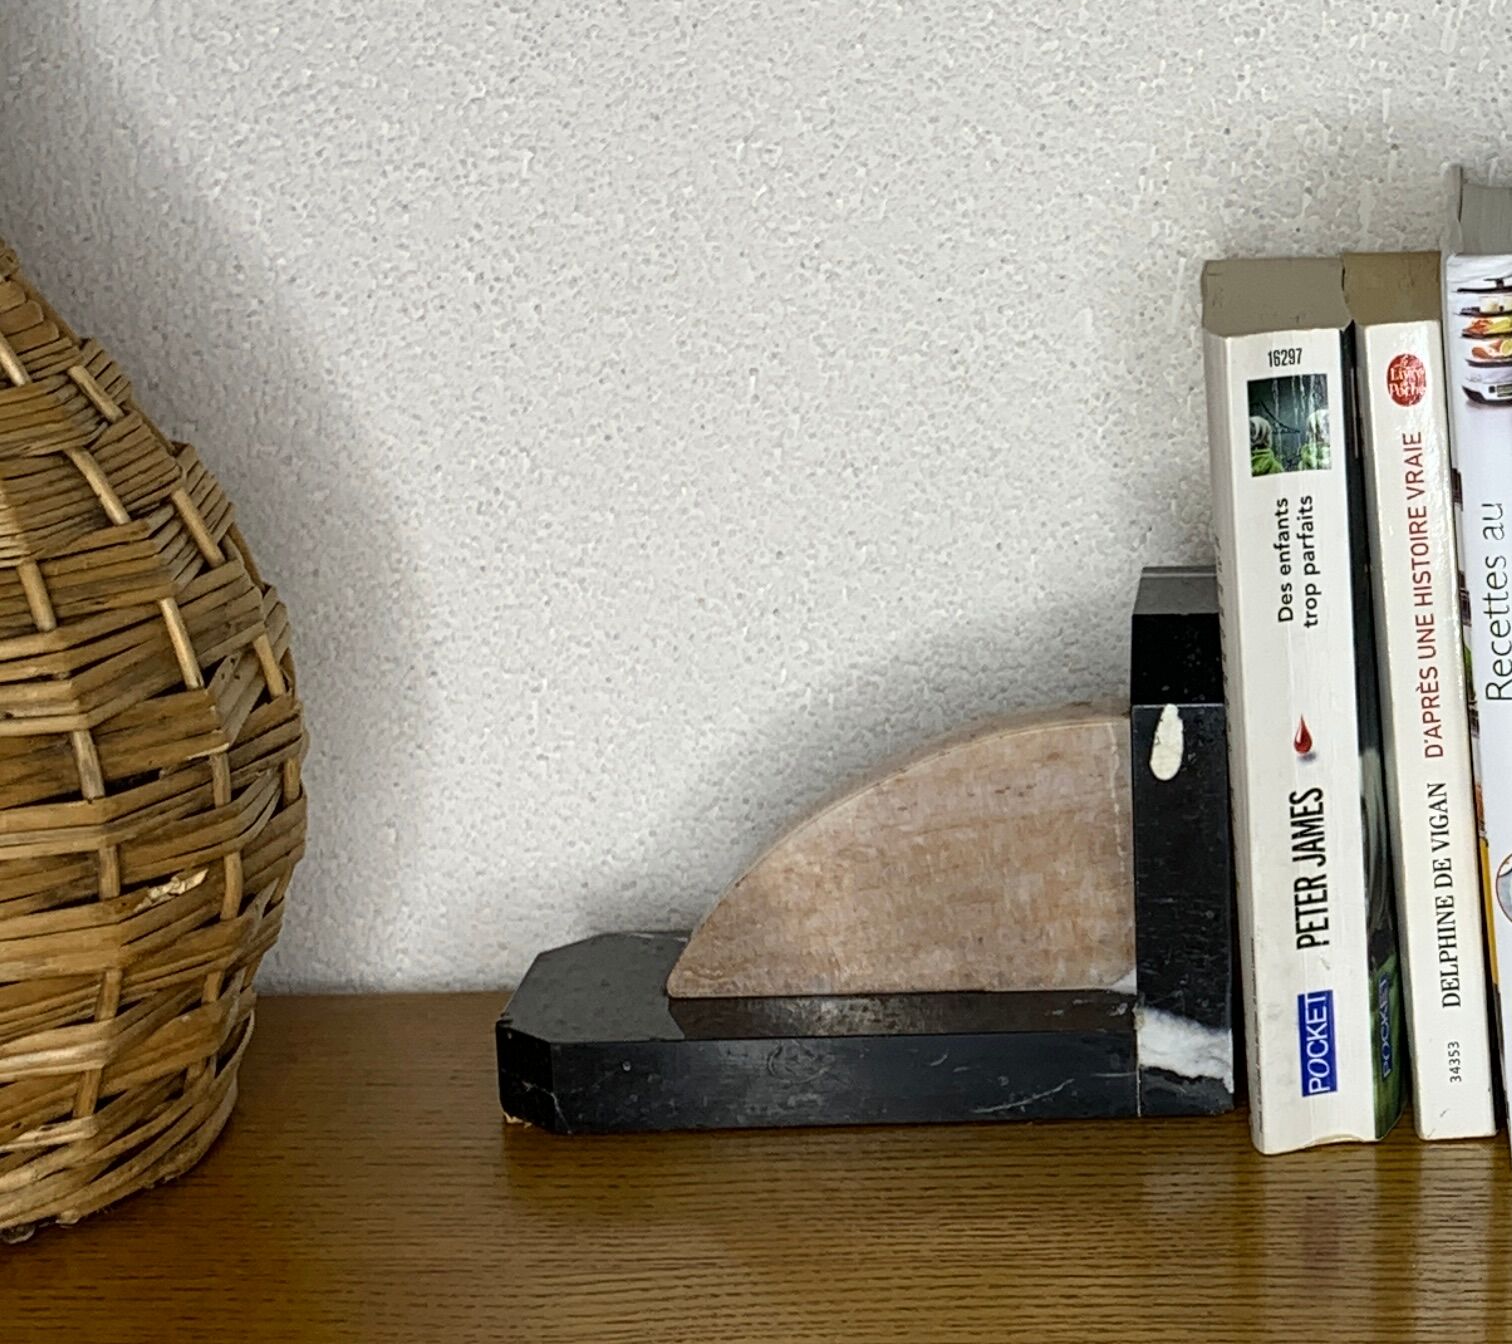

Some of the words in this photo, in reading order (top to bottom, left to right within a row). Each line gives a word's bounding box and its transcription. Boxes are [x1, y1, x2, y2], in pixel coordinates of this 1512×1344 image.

[1267, 348, 1303, 367] 16297
[1403, 431, 1426, 501] VRAIE
[1273, 497, 1291, 574] enfants
[1296, 494, 1320, 577] parfaits
[1408, 505, 1434, 608] HISTOIRE
[1482, 502, 1505, 542] au
[1278, 583, 1294, 623] Des
[1304, 583, 1322, 628] trop
[1416, 612, 1437, 663] UNE
[1416, 665, 1445, 758] D'APRÈS
[1289, 787, 1327, 868] JAMES
[1427, 783, 1450, 853] VIGAN
[1430, 858, 1454, 888] DE
[1294, 874, 1330, 950] PETER
[1432, 894, 1461, 1008] DELPHINE
[1302, 992, 1331, 1094] POCKET
[1449, 1040, 1461, 1083] 34353
